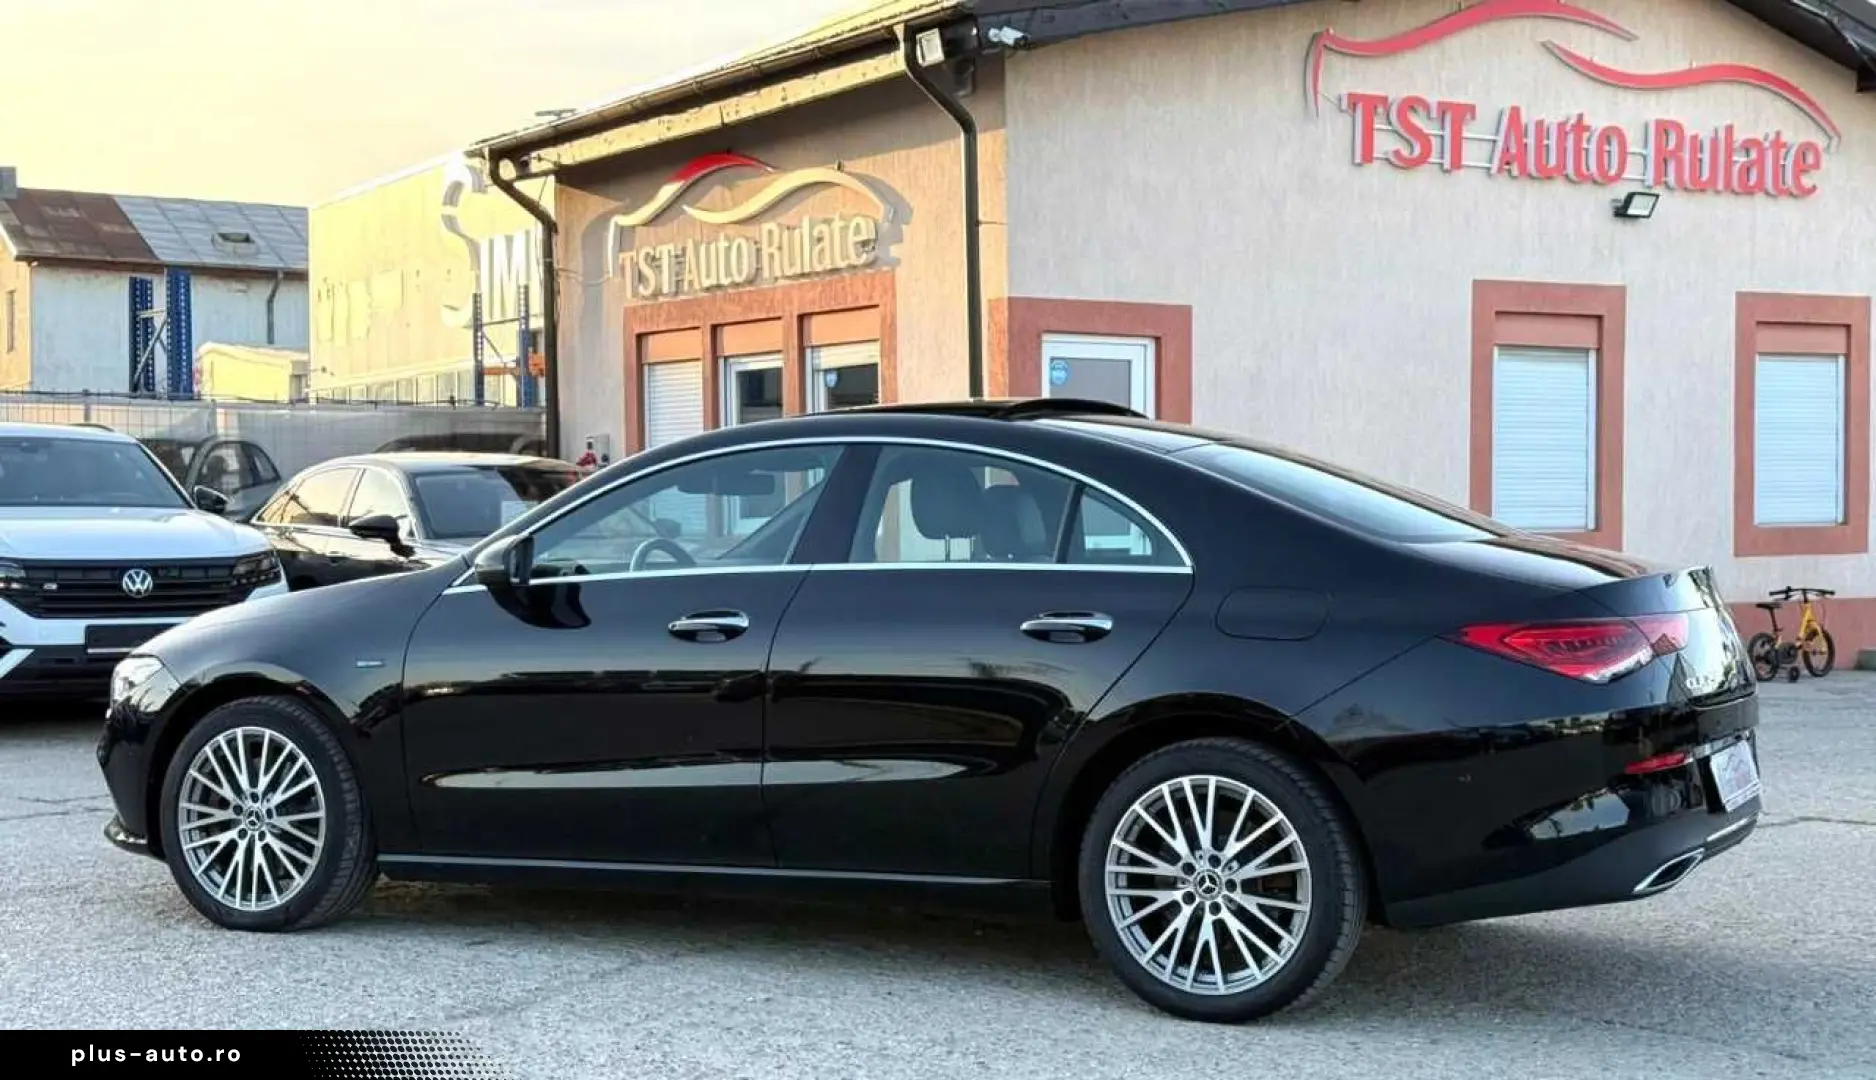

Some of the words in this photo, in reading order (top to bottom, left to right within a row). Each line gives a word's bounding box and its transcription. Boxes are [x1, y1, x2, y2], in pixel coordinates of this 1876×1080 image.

[1341, 92, 1476, 171] TST
[1490, 104, 1628, 186] Auto
[1644, 118, 1822, 199] Rulate
[441, 152, 543, 329] SIM
[618, 242, 677, 300] TST
[682, 232, 749, 293] Auto
[761, 212, 876, 281] Rulate
